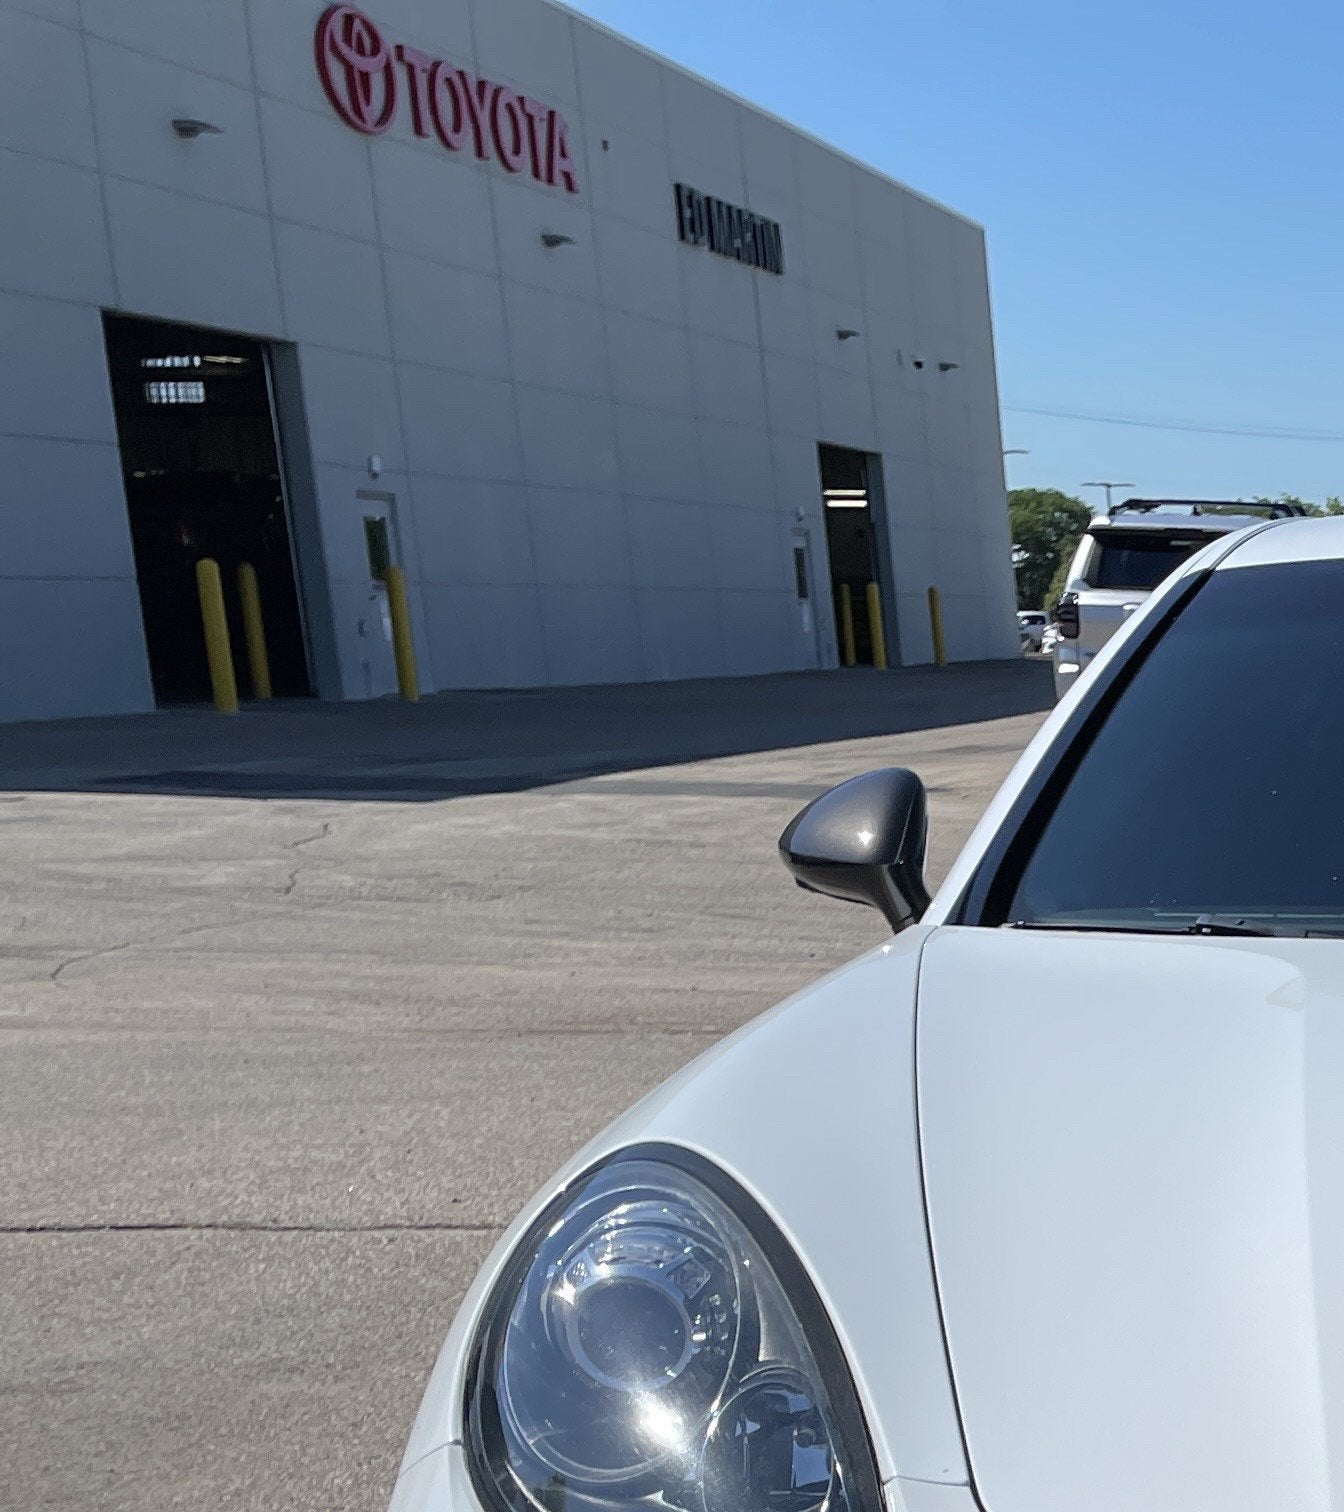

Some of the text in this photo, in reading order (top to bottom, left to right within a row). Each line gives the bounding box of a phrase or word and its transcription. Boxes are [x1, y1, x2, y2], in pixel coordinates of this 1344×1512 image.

[395, 44, 580, 193] TOYOTA
[674, 182, 784, 276] ED MARTIN
